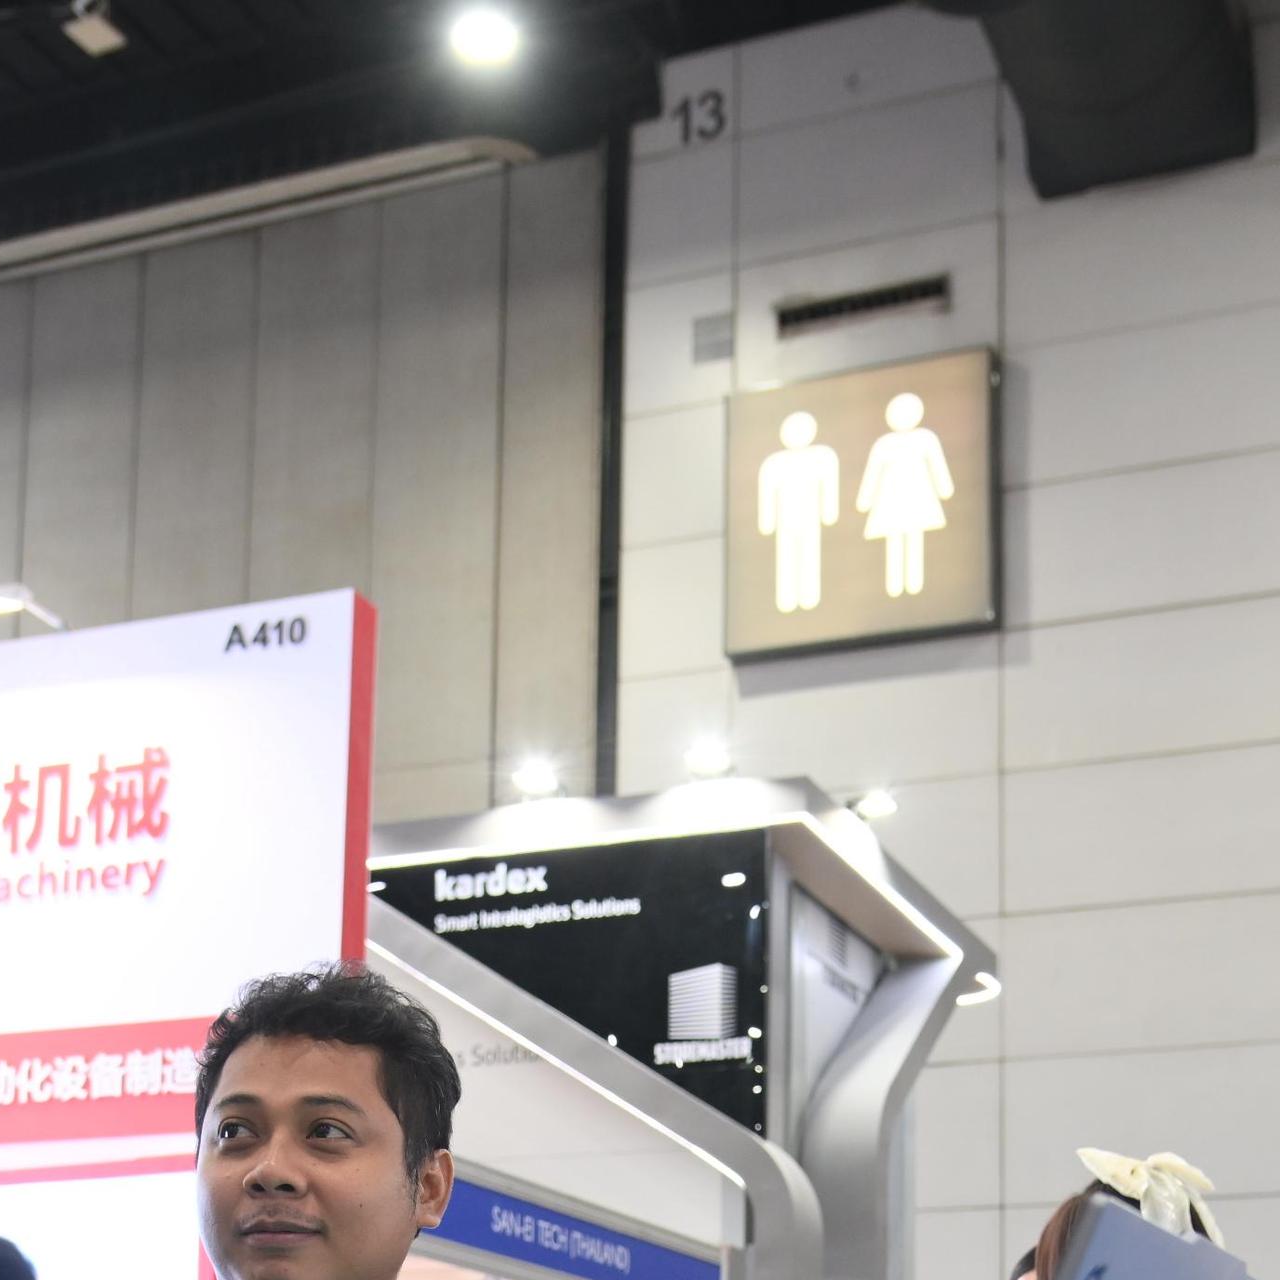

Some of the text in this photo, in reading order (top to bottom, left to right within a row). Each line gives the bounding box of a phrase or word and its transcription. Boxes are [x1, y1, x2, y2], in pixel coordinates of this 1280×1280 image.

[670, 91, 727, 146] 13
[225, 616, 307, 653] A410
[434, 861, 549, 902] kardex
